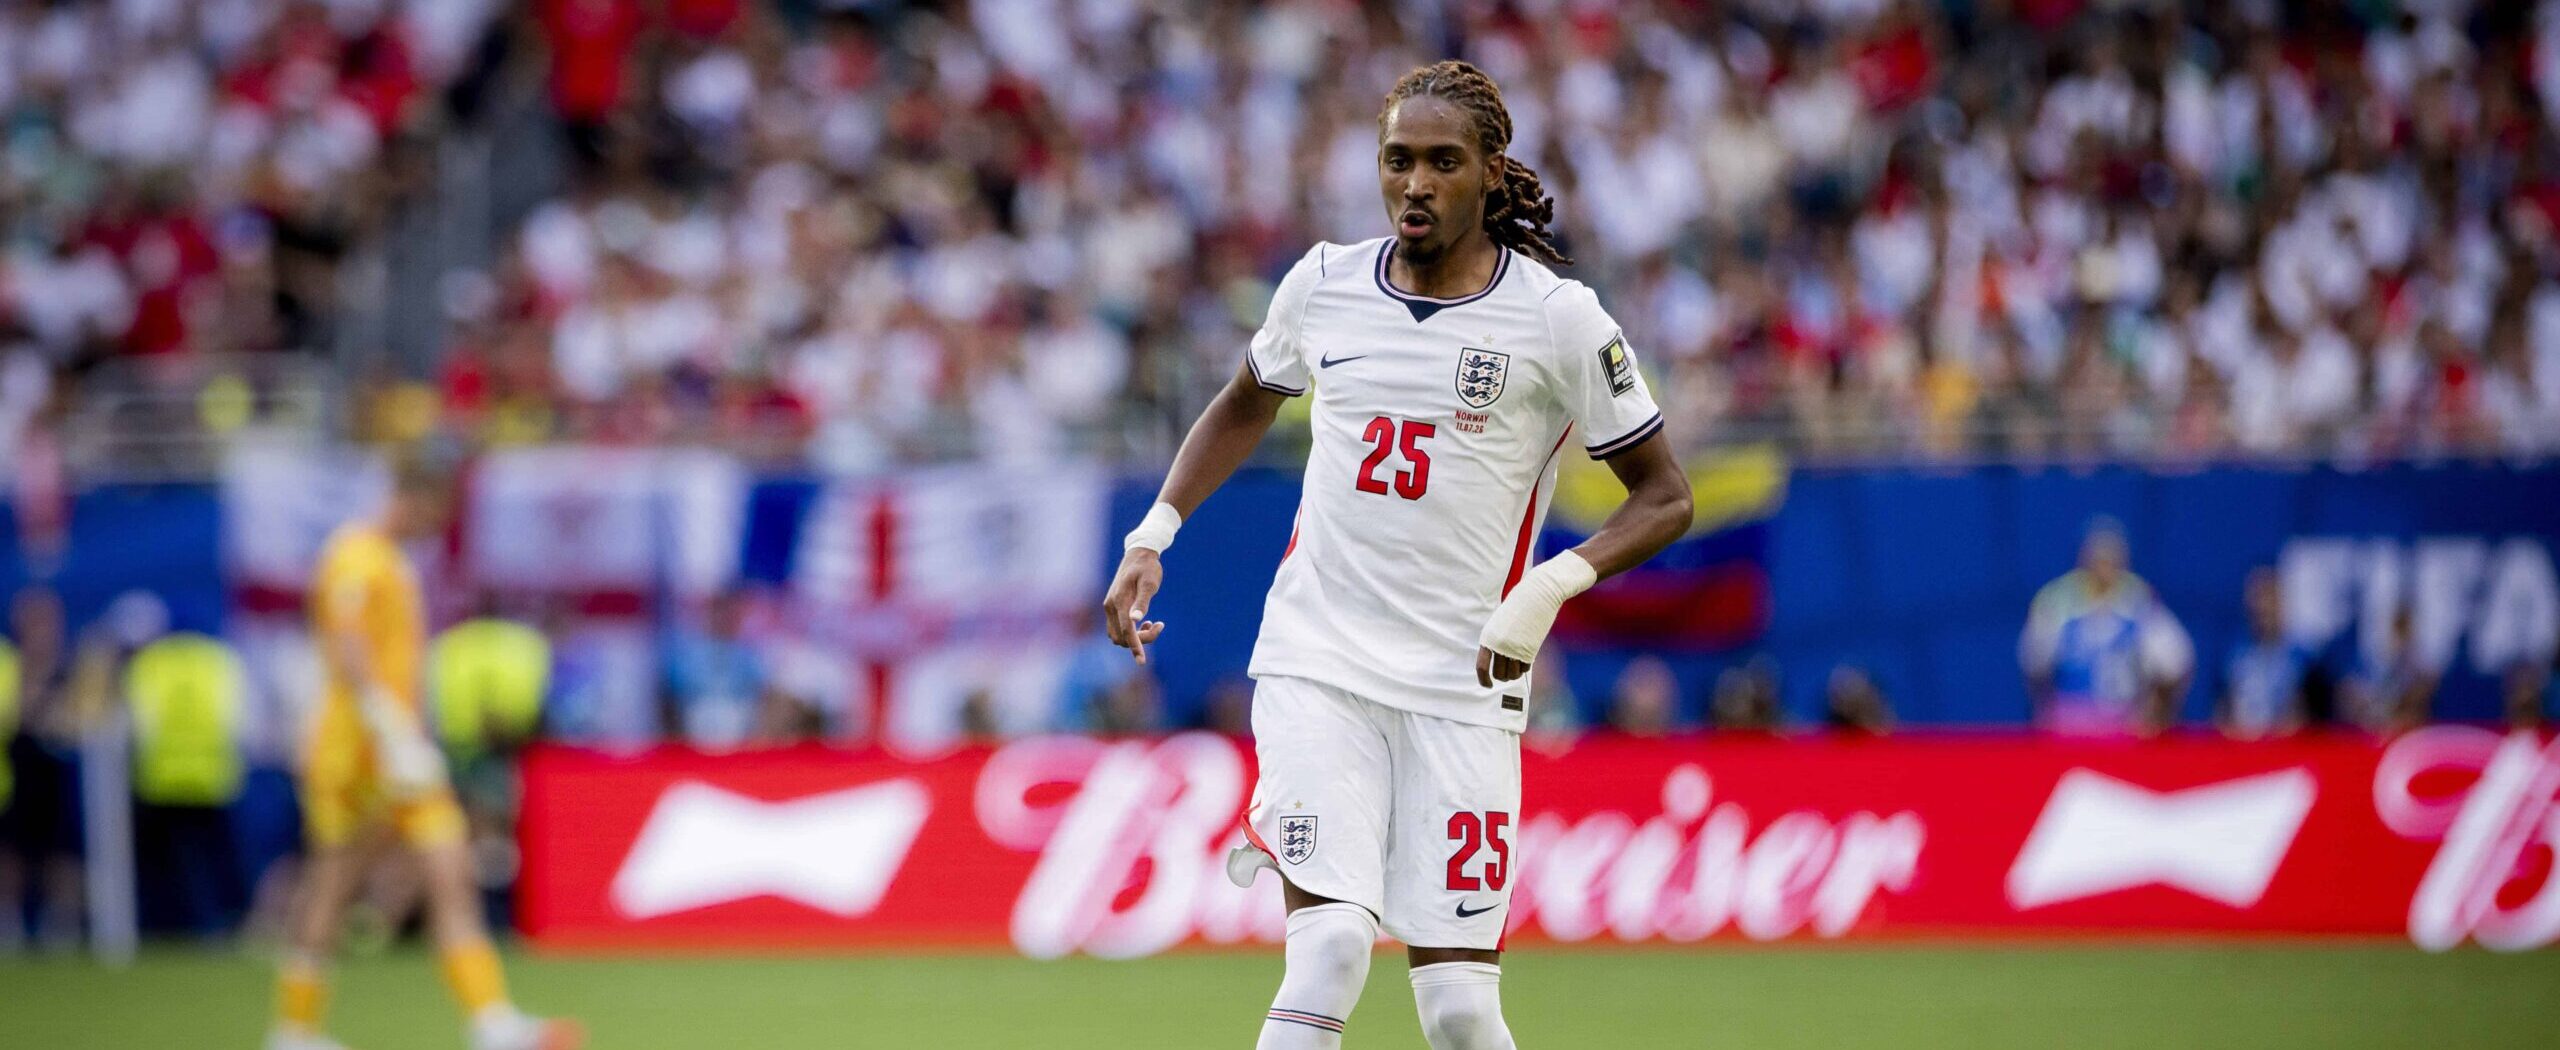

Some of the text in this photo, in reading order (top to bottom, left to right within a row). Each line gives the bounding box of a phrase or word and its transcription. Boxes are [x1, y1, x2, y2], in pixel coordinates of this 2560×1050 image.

[1455, 410, 1489, 423] NORWAY
[1456, 422, 1484, 434] 11.07.26
[1355, 415, 1436, 501] 25
[2279, 535, 2560, 675] FIFA
[1446, 811, 1510, 892] 25
